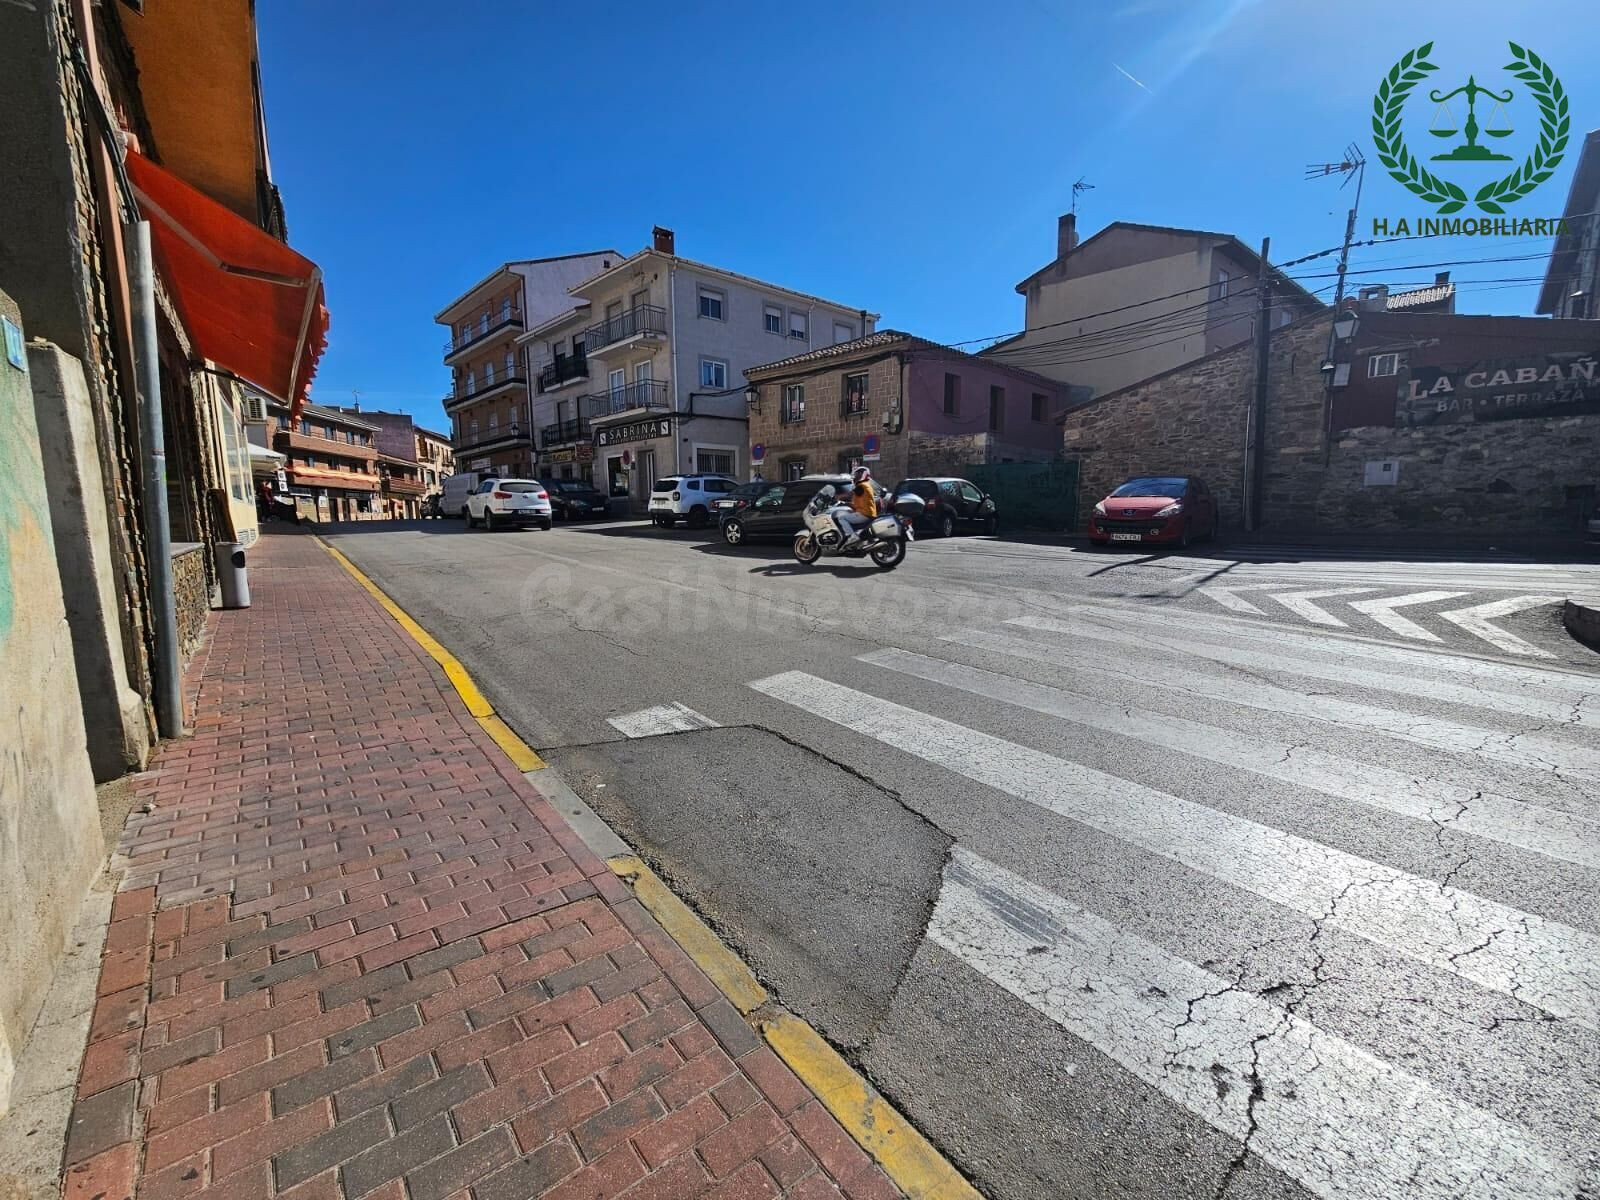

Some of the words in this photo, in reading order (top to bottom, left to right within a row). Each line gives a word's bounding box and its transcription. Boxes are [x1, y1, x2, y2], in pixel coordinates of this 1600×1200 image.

[1407, 376, 1454, 401] LA
[1464, 357, 1600, 388] CABAÑ
[1436, 398, 1473, 412] BAR
[1493, 389, 1585, 408] TERRAZA
[609, 422, 657, 440] SABRINA
